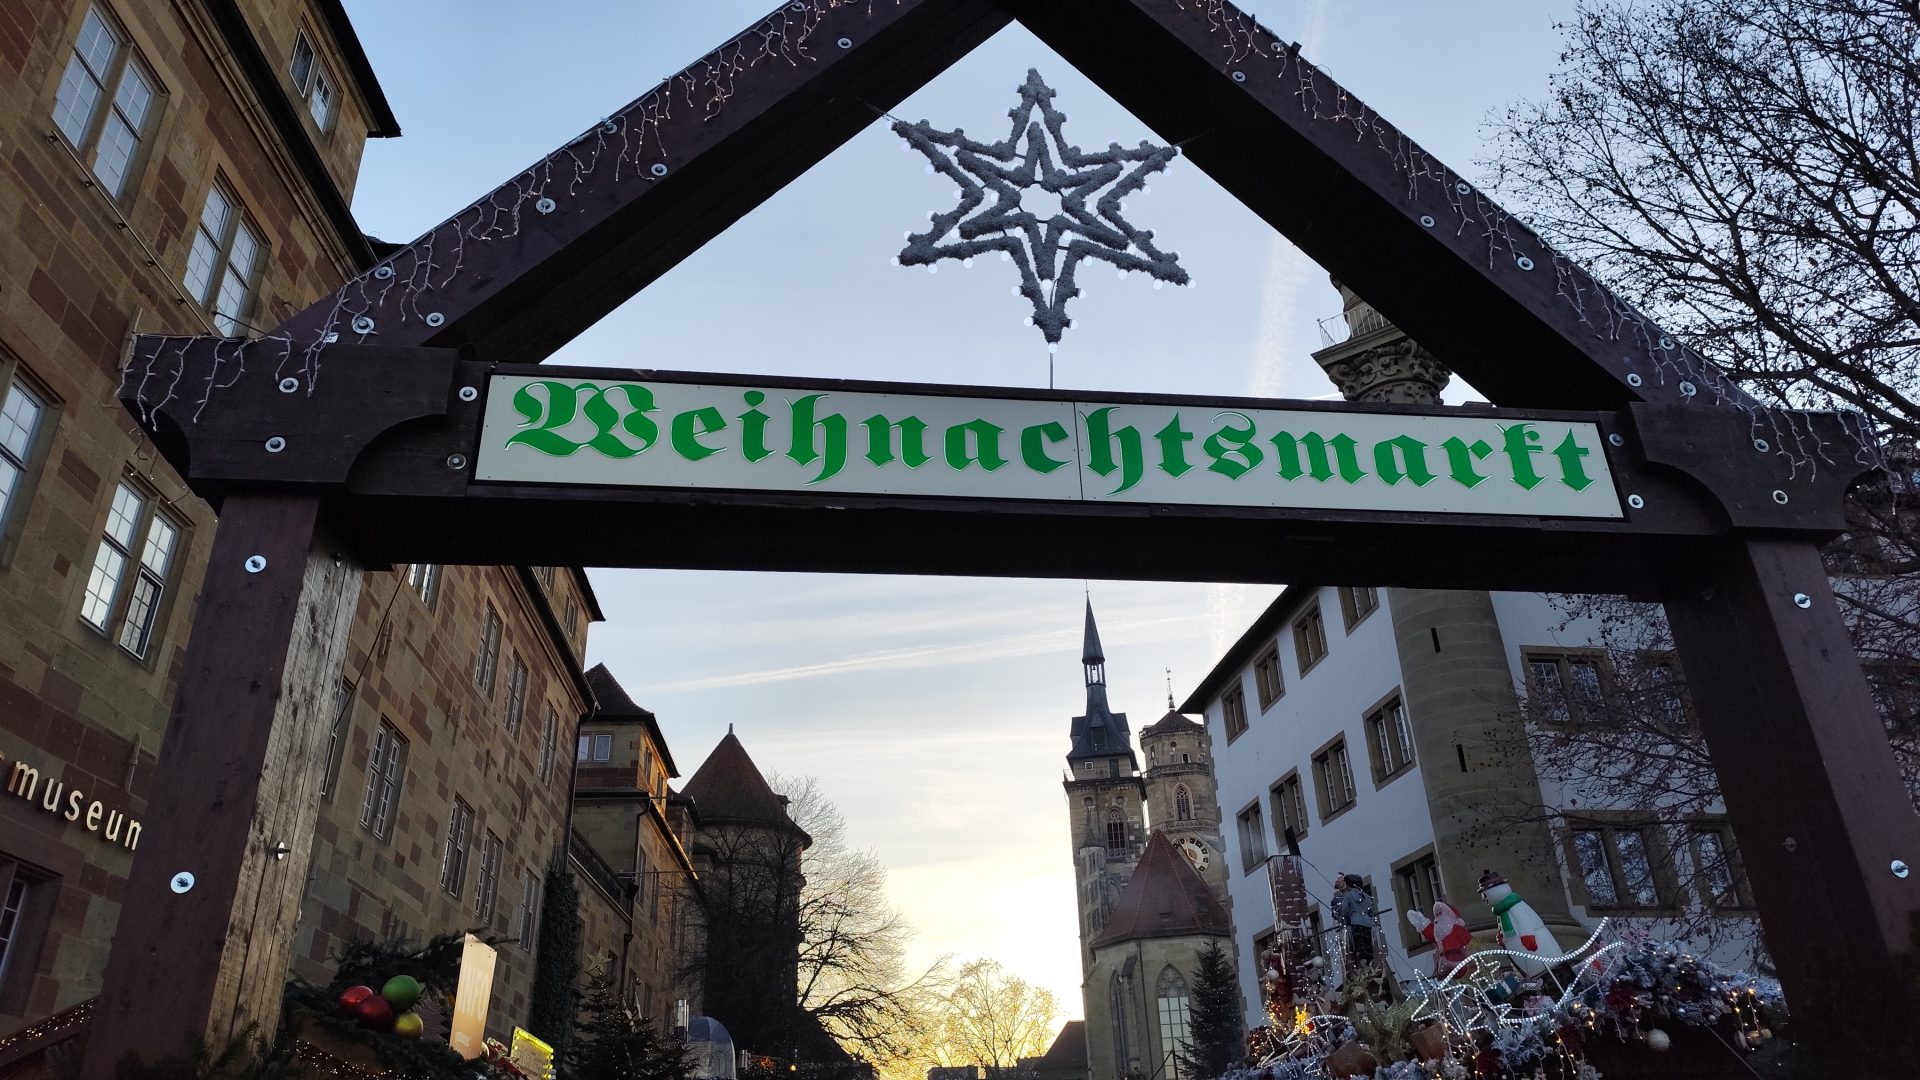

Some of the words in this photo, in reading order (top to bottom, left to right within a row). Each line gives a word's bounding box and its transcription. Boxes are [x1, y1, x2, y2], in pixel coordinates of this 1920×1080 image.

[505, 380, 1596, 497] Weihnachtsmarkt
[0, 752, 142, 851] museum
[457, 961, 489, 1022] INFO
